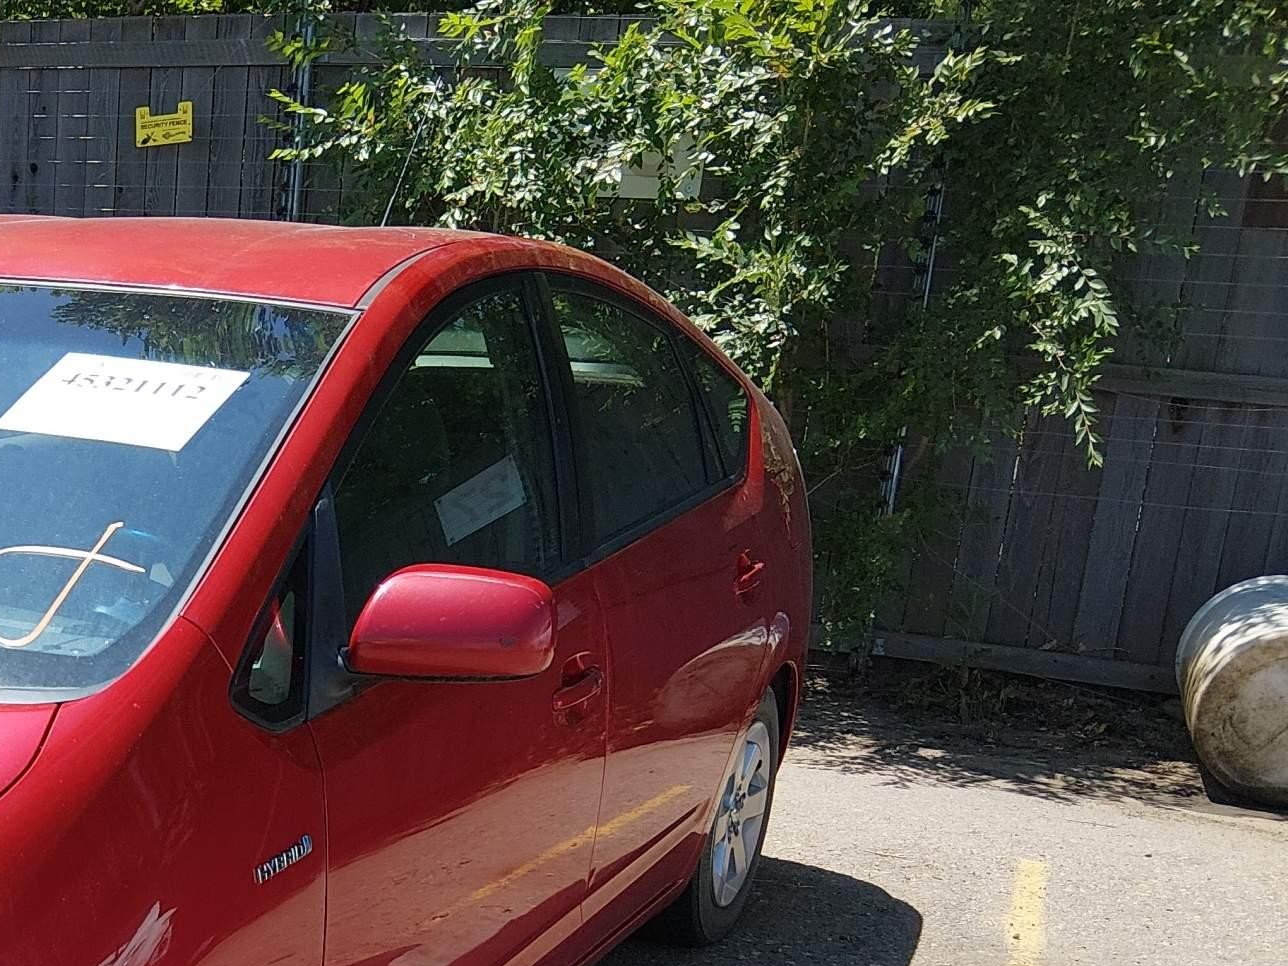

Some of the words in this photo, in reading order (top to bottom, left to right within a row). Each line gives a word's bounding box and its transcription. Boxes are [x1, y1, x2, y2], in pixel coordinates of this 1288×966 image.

[140, 121, 168, 130] SECURITY
[168, 119, 188, 127] FENCE
[61, 372, 207, 400] 45321112
[255, 840, 308, 885] HYBRID
